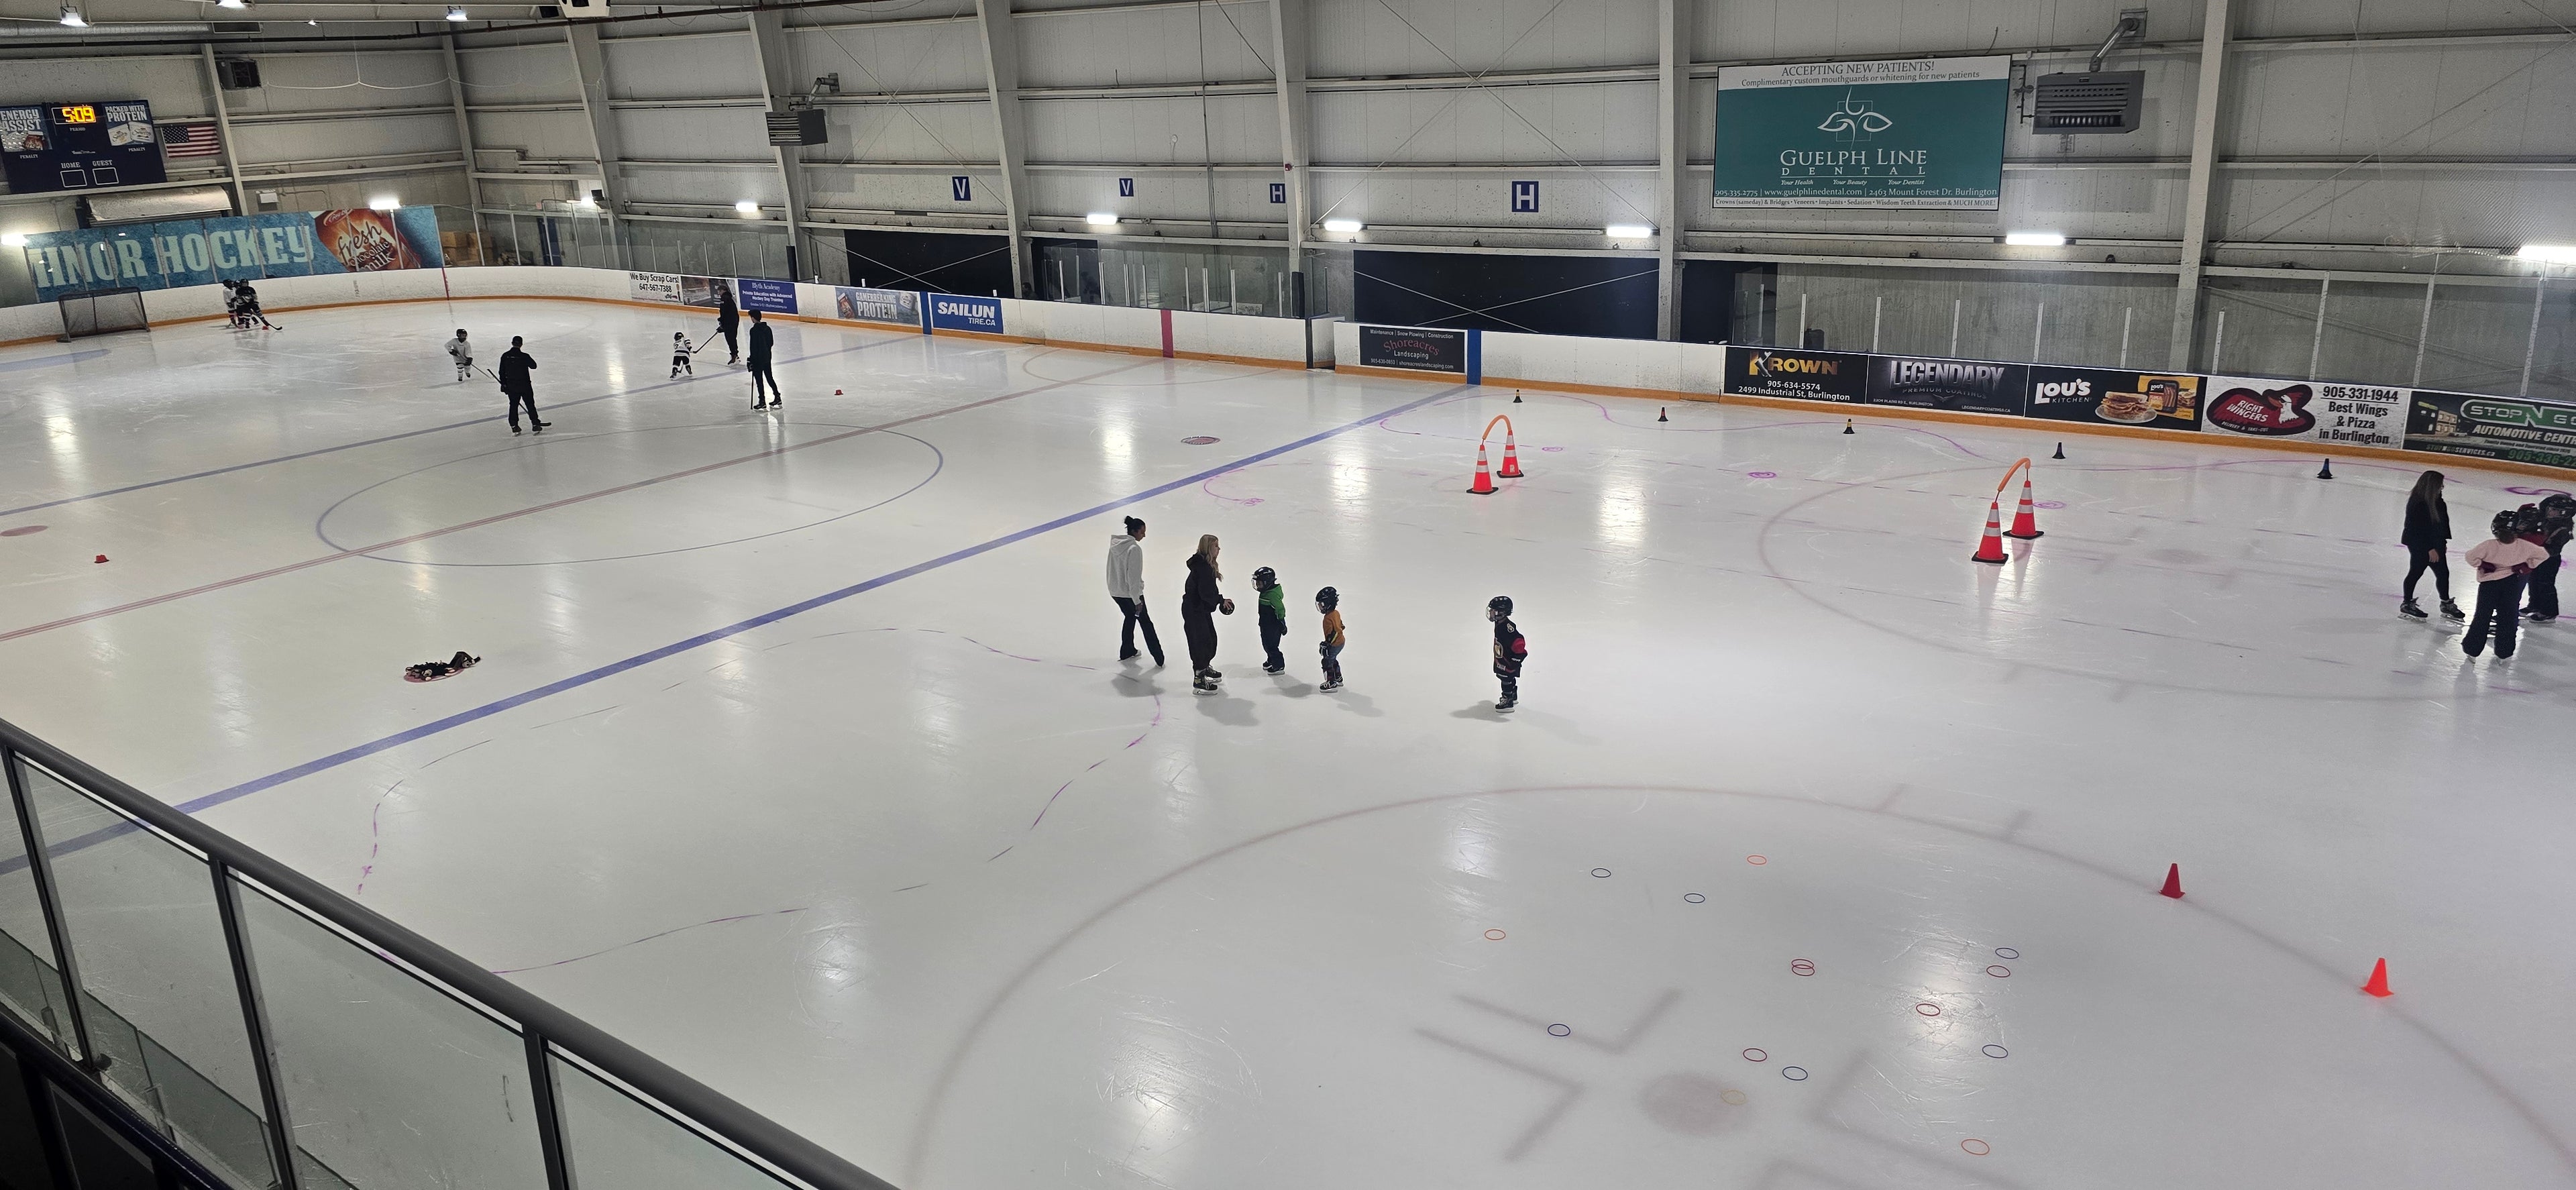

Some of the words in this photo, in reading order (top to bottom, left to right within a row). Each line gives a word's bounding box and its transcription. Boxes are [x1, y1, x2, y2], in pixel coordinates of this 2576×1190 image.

[1782, 64, 1843, 76] ACCEPTING
[1846, 63, 1874, 74] NEW
[1877, 61, 1935, 73] PATIENTS!
[1741, 76, 1793, 87] Complimentary
[1821, 74, 1870, 84] mouthguards
[1880, 72, 1917, 82] whitening
[1919, 72, 1930, 80] for
[1948, 71, 1980, 80] patients
[0, 109, 40, 121] ENERGY
[62, 106, 97, 123] 5:09
[107, 111, 148, 122] PROTEIN
[2, 119, 41, 131] ASSIST
[1780, 150, 1866, 166] GUELPH
[1876, 148, 1927, 165] LINE
[1782, 166, 1925, 175] DENTAL
[955, 178, 967, 199] V
[1121, 180, 1131, 195] V
[1272, 185, 1283, 202] H
[1715, 188, 1758, 197] 905.335.2775
[1764, 188, 1862, 197] www.guelphlinedental.com
[1869, 188, 1887, 197] 2463
[1888, 188, 1914, 196] Mount
[1916, 188, 1939, 196] Forest
[1955, 188, 1997, 197] Burlington
[1517, 184, 1534, 209] H
[154, 225, 314, 274] HOCKEY
[337, 221, 382, 266] fresh
[349, 239, 390, 266] chocolate
[630, 272, 639, 280] We
[639, 273, 649, 283] Buy
[651, 274, 665, 283] Scrap
[666, 274, 679, 283] Cars!
[639, 283, 672, 292] 647-567-7388
[855, 292, 896, 303] GAMEBREAKING
[857, 301, 898, 319] PROTEIN
[937, 302, 996, 319] SAILUN
[968, 317, 996, 326] TIRE.CA
[1383, 338, 1440, 357] Shoreacres
[1394, 350, 1429, 360] Landscaping
[1399, 361, 1454, 370] shoreacreslandscaping.com
[1749, 351, 1838, 378] KROWN
[1890, 360, 2005, 390] LEGENDARY
[1767, 380, 1821, 391] 905-634-5574
[2035, 378, 2091, 404] LOU'S
[1738, 386, 1757, 394] 2499
[1758, 387, 1794, 397] Industrial
[1796, 390, 1806, 398] St,
[1808, 391, 1850, 401] Burlington
[1945, 388, 1987, 400] COATINGS
[2323, 386, 2399, 402] 905-331-1944
[2226, 403, 2269, 423] WINGERS
[2237, 400, 2264, 413] RIGHT
[2328, 401, 2353, 413] Best
[2356, 403, 2388, 417] Wings
[2470, 405, 2522, 419] STOP
[2337, 416, 2345, 427] &
[2347, 417, 2375, 429] Pizza
[2318, 429, 2329, 439] in
[2332, 429, 2390, 444] Burlington
[2472, 425, 2542, 441] AUTOMOTIVE
